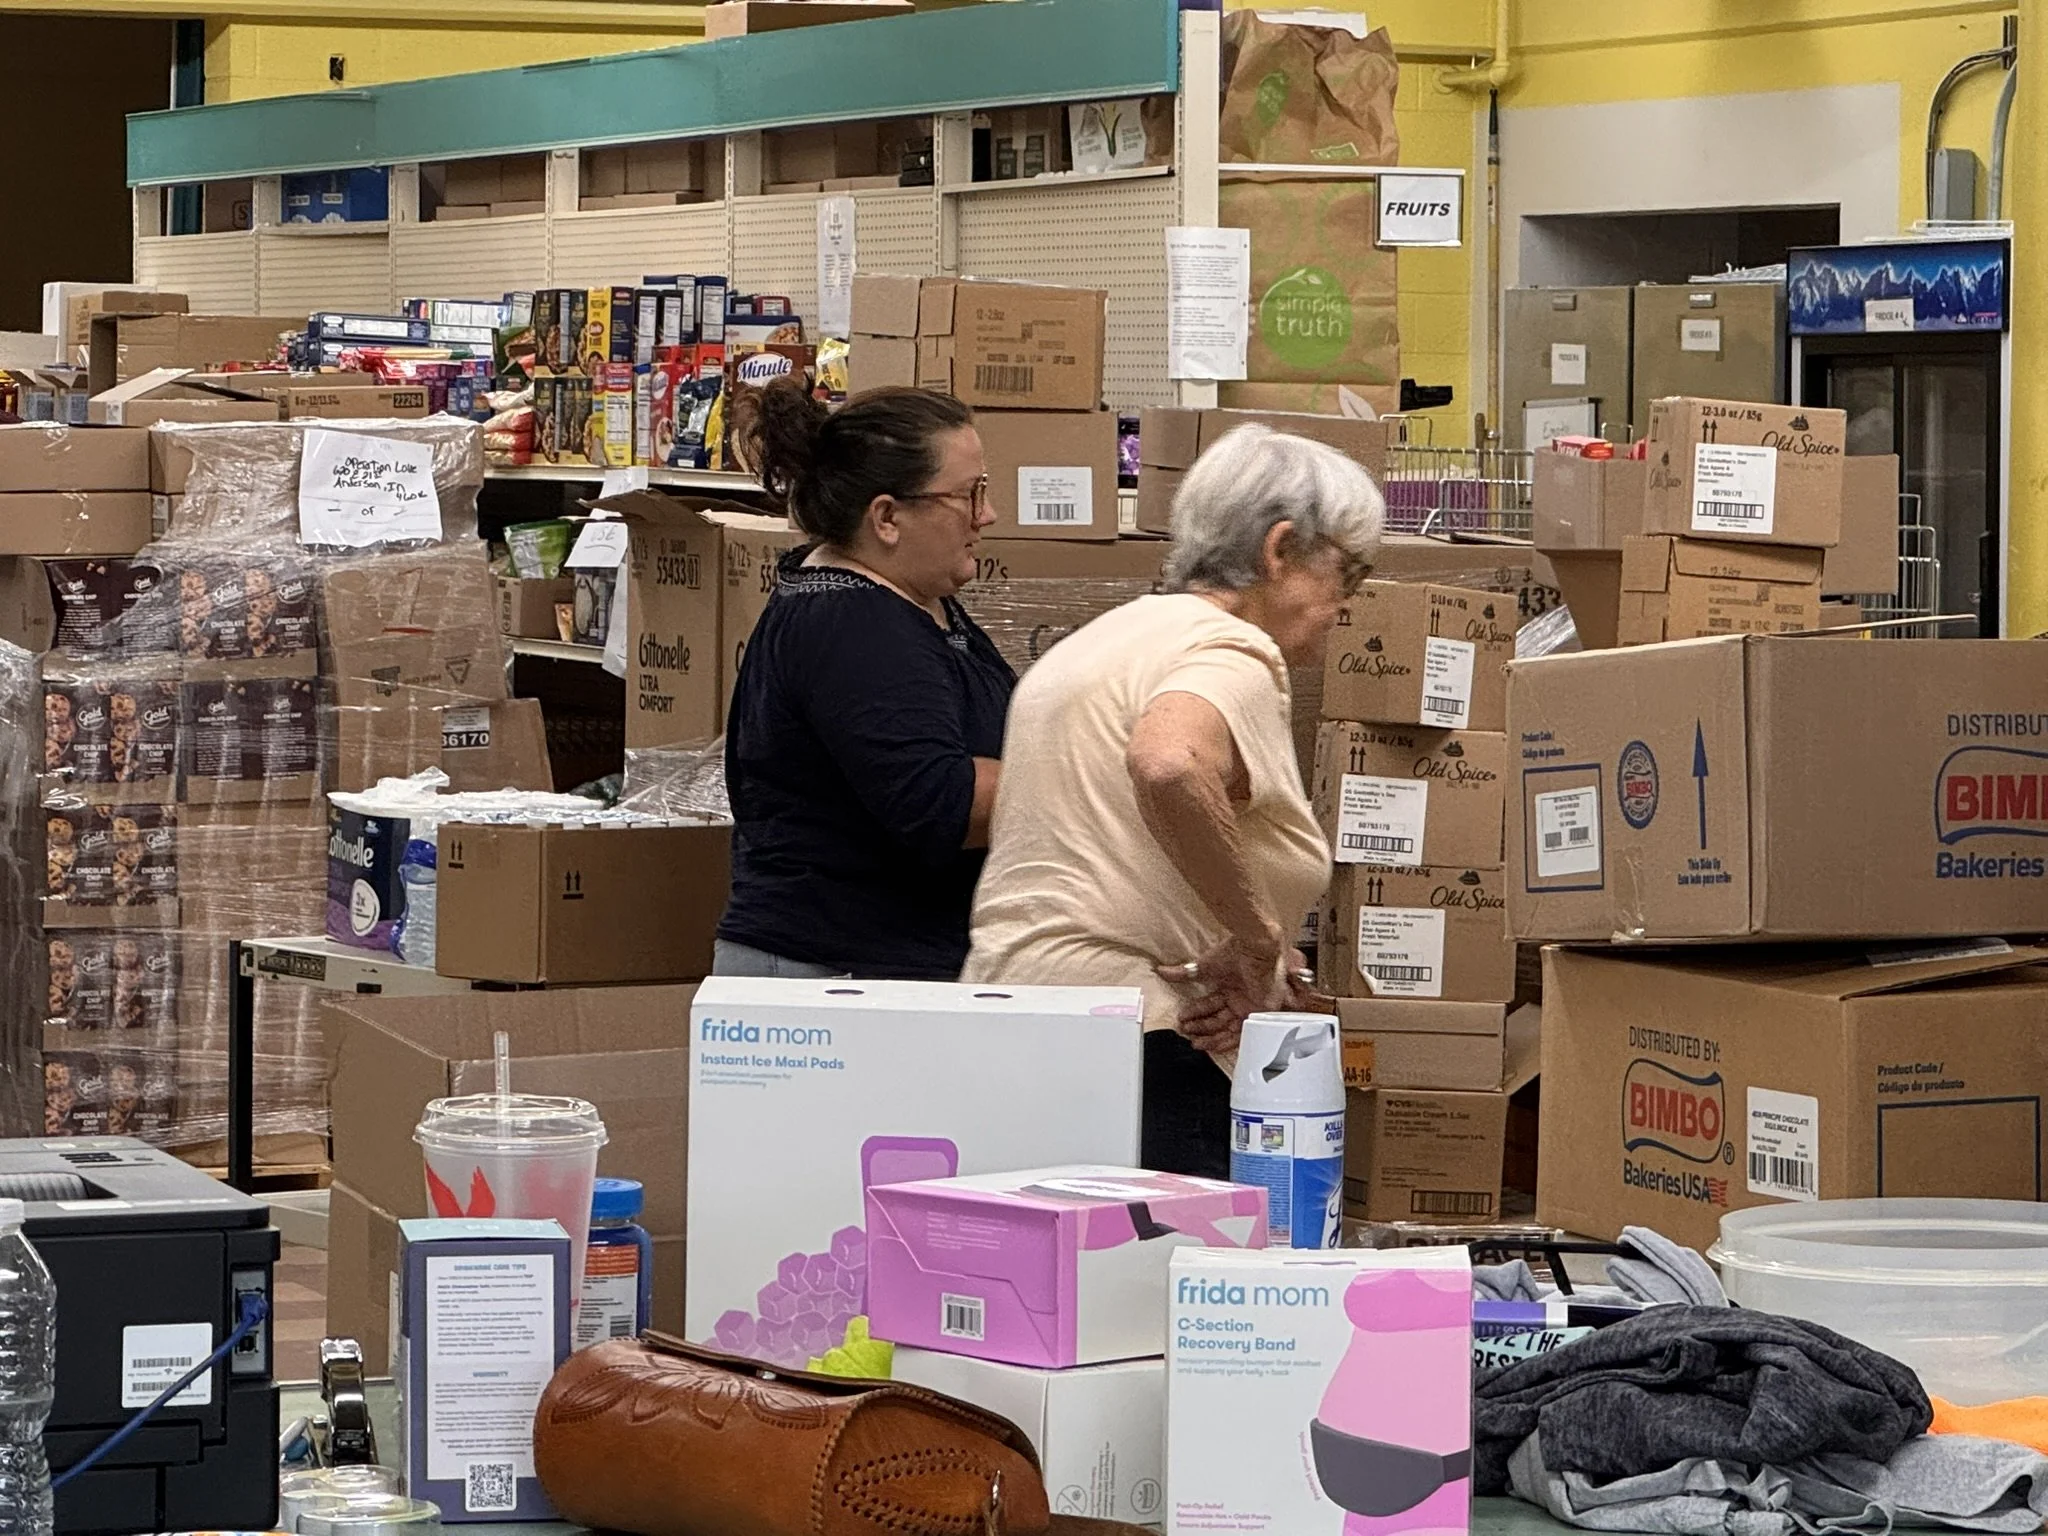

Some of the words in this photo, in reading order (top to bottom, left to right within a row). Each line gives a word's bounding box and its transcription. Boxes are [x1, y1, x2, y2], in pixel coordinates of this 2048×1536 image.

[1385, 202, 1452, 217] FRUITS
[1275, 292, 1343, 314] simple
[1275, 315, 1344, 337] truth
[737, 355, 794, 381] Minute
[394, 393, 424, 408] 22264
[1702, 406, 1726, 417] 12-3.0
[1761, 430, 1796, 451] Old
[1793, 433, 1836, 457] Spice
[214, 582, 240, 603] Gold
[279, 581, 304, 599] Gold
[211, 619, 245, 629] CHOCOLATE
[1465, 619, 1487, 641] Old
[1486, 622, 1510, 646] Spice
[1338, 652, 1368, 675] Old
[1368, 656, 1407, 680] Spice
[639, 674, 659, 692] LTRA
[79, 706, 103, 724] Gold
[143, 706, 168, 724] Gold
[639, 695, 674, 714] OMFORT
[74, 743, 108, 751] CHOCOLATE
[1350, 731, 1376, 744] 12-3.0
[1413, 756, 1448, 778] Old
[1448, 760, 1493, 784] Spice
[1946, 774, 2048, 822] BIM
[329, 829, 374, 868] ottonelle
[1936, 851, 2045, 879] Bakeries
[1430, 886, 1465, 907] Old
[701, 1017, 761, 1043] frida
[766, 1026, 832, 1047] mom
[1629, 1025, 1701, 1060] DISTRIBUTED
[1703, 1041, 1721, 1064] BY:
[701, 1053, 749, 1066] Instant
[752, 1055, 772, 1067] Ice
[775, 1055, 808, 1069] Maxi
[811, 1057, 845, 1070] Pads
[1878, 1063, 1913, 1077] Product
[1915, 1063, 1937, 1075] Code
[1878, 1080, 1909, 1095] Código
[1630, 1081, 1721, 1142] BIMBO
[1624, 1158, 1681, 1198] Bakeries
[1682, 1175, 1712, 1204] USA
[1177, 1276, 1246, 1305] frida
[1253, 1285, 1329, 1307] mom
[1177, 1318, 1254, 1333] C-Section
[1177, 1335, 1251, 1354] Recovery
[1255, 1337, 1296, 1351] Band
